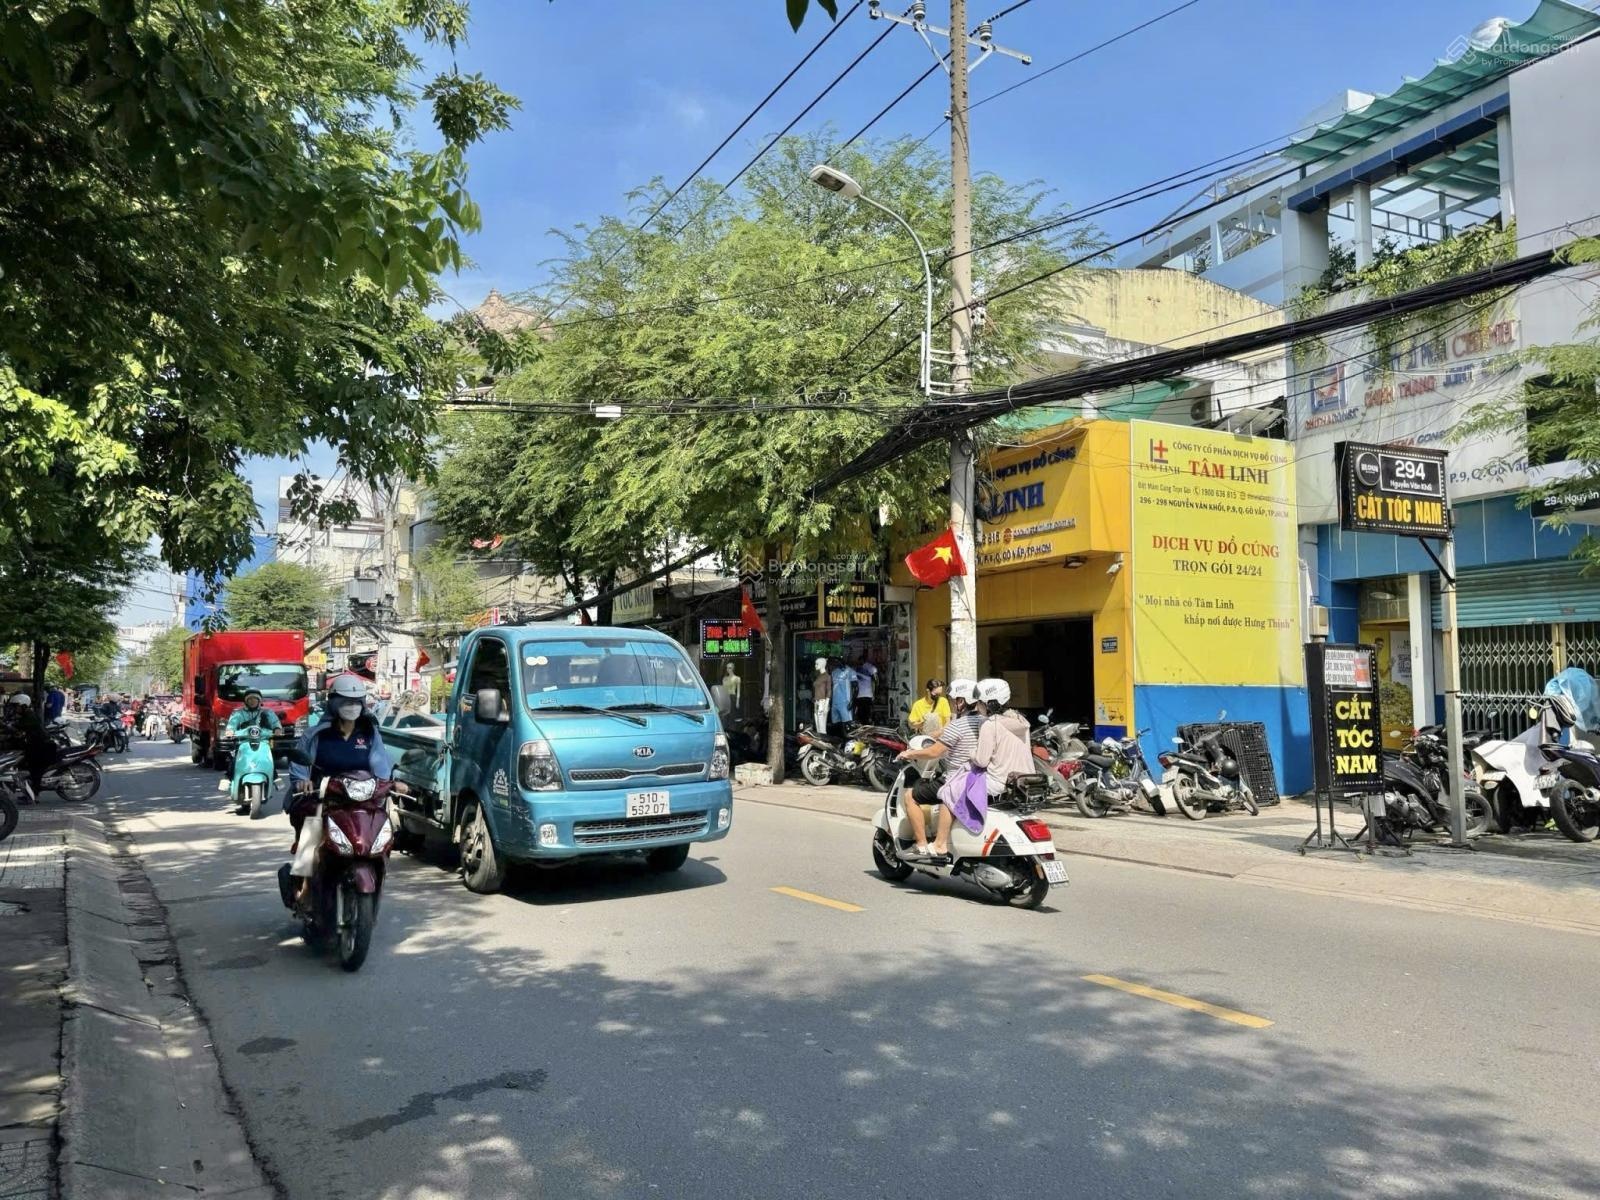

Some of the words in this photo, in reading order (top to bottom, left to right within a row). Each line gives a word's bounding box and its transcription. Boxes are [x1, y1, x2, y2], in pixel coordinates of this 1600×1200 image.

[1173, 441, 1192, 452] CÔNG
[1193, 444, 1202, 452] TY
[1233, 449, 1249, 459] DỊCH
[1188, 457, 1225, 480] TÂM
[1229, 465, 1269, 485] LINH
[1394, 460, 1425, 480] 294
[990, 482, 1045, 518] LINH
[1139, 496, 1152, 505] 296
[1169, 496, 1195, 509] NGUYỄN
[1358, 490, 1383, 520] CẮT
[1386, 495, 1411, 522] TÓC
[1415, 500, 1442, 524] NAM
[1152, 535, 1189, 553] DỊCH
[1194, 538, 1214, 556] VỤ
[1218, 535, 1238, 555] ĐỒ
[1241, 540, 1280, 558] CÚNG
[1173, 559, 1208, 576] TRỌN
[1210, 559, 1233, 575] GÓI
[1236, 564, 1263, 577] 24/24
[1164, 596, 1180, 607] nhà
[1182, 597, 1193, 608] có
[1194, 597, 1213, 609] Tâm
[1215, 598, 1235, 610] Linh
[1184, 613, 1206, 628] khắp
[1207, 615, 1221, 626] nơi
[1222, 616, 1243, 628] được
[1244, 617, 1266, 629] Hưng
[1335, 694, 1372, 720] CẮT
[1336, 724, 1373, 748] TÓC
[636, 748, 652, 756] KIA
[1336, 755, 1377, 774] NAM
